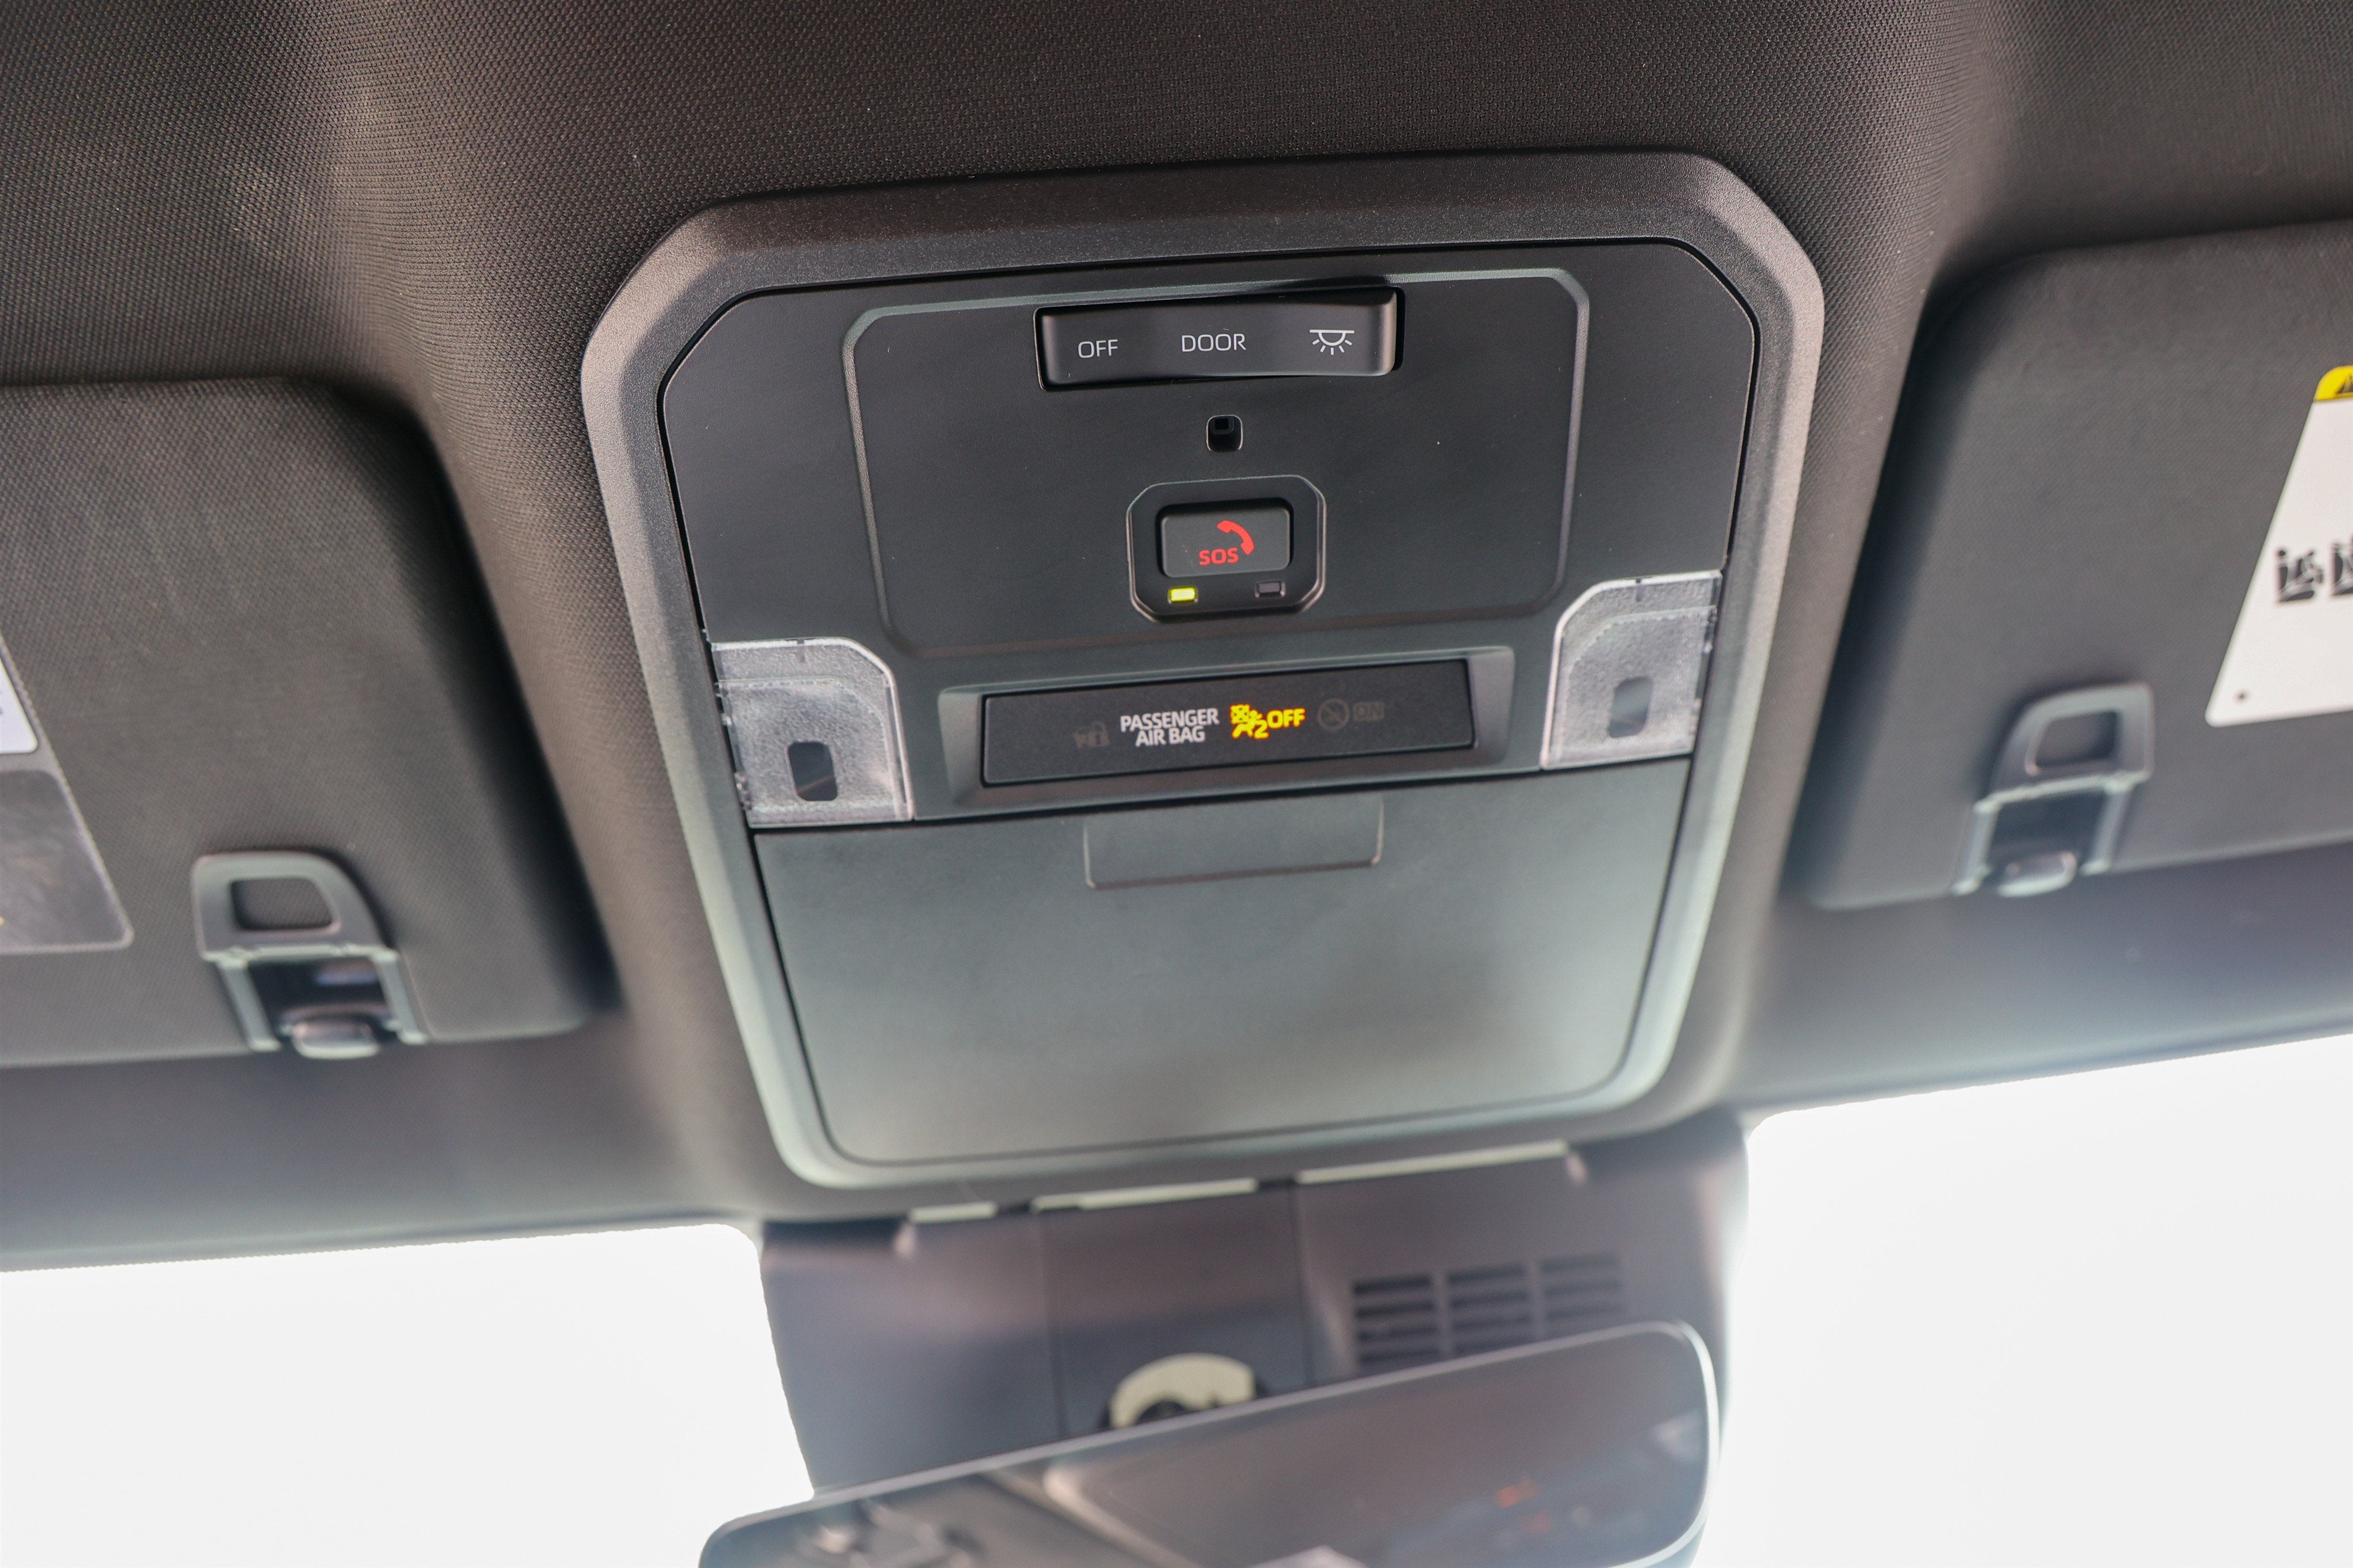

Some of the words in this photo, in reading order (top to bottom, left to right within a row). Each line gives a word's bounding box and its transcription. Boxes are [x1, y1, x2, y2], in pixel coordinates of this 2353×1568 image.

[1078, 339, 1118, 358] OFF
[1182, 333, 1246, 352] DOOR
[1198, 547, 1239, 565] SOS
[1120, 708, 1220, 732] PASSENGER
[1267, 708, 1306, 729] OFF
[1135, 726, 1165, 747] AIR
[1169, 724, 1206, 745] BAG
